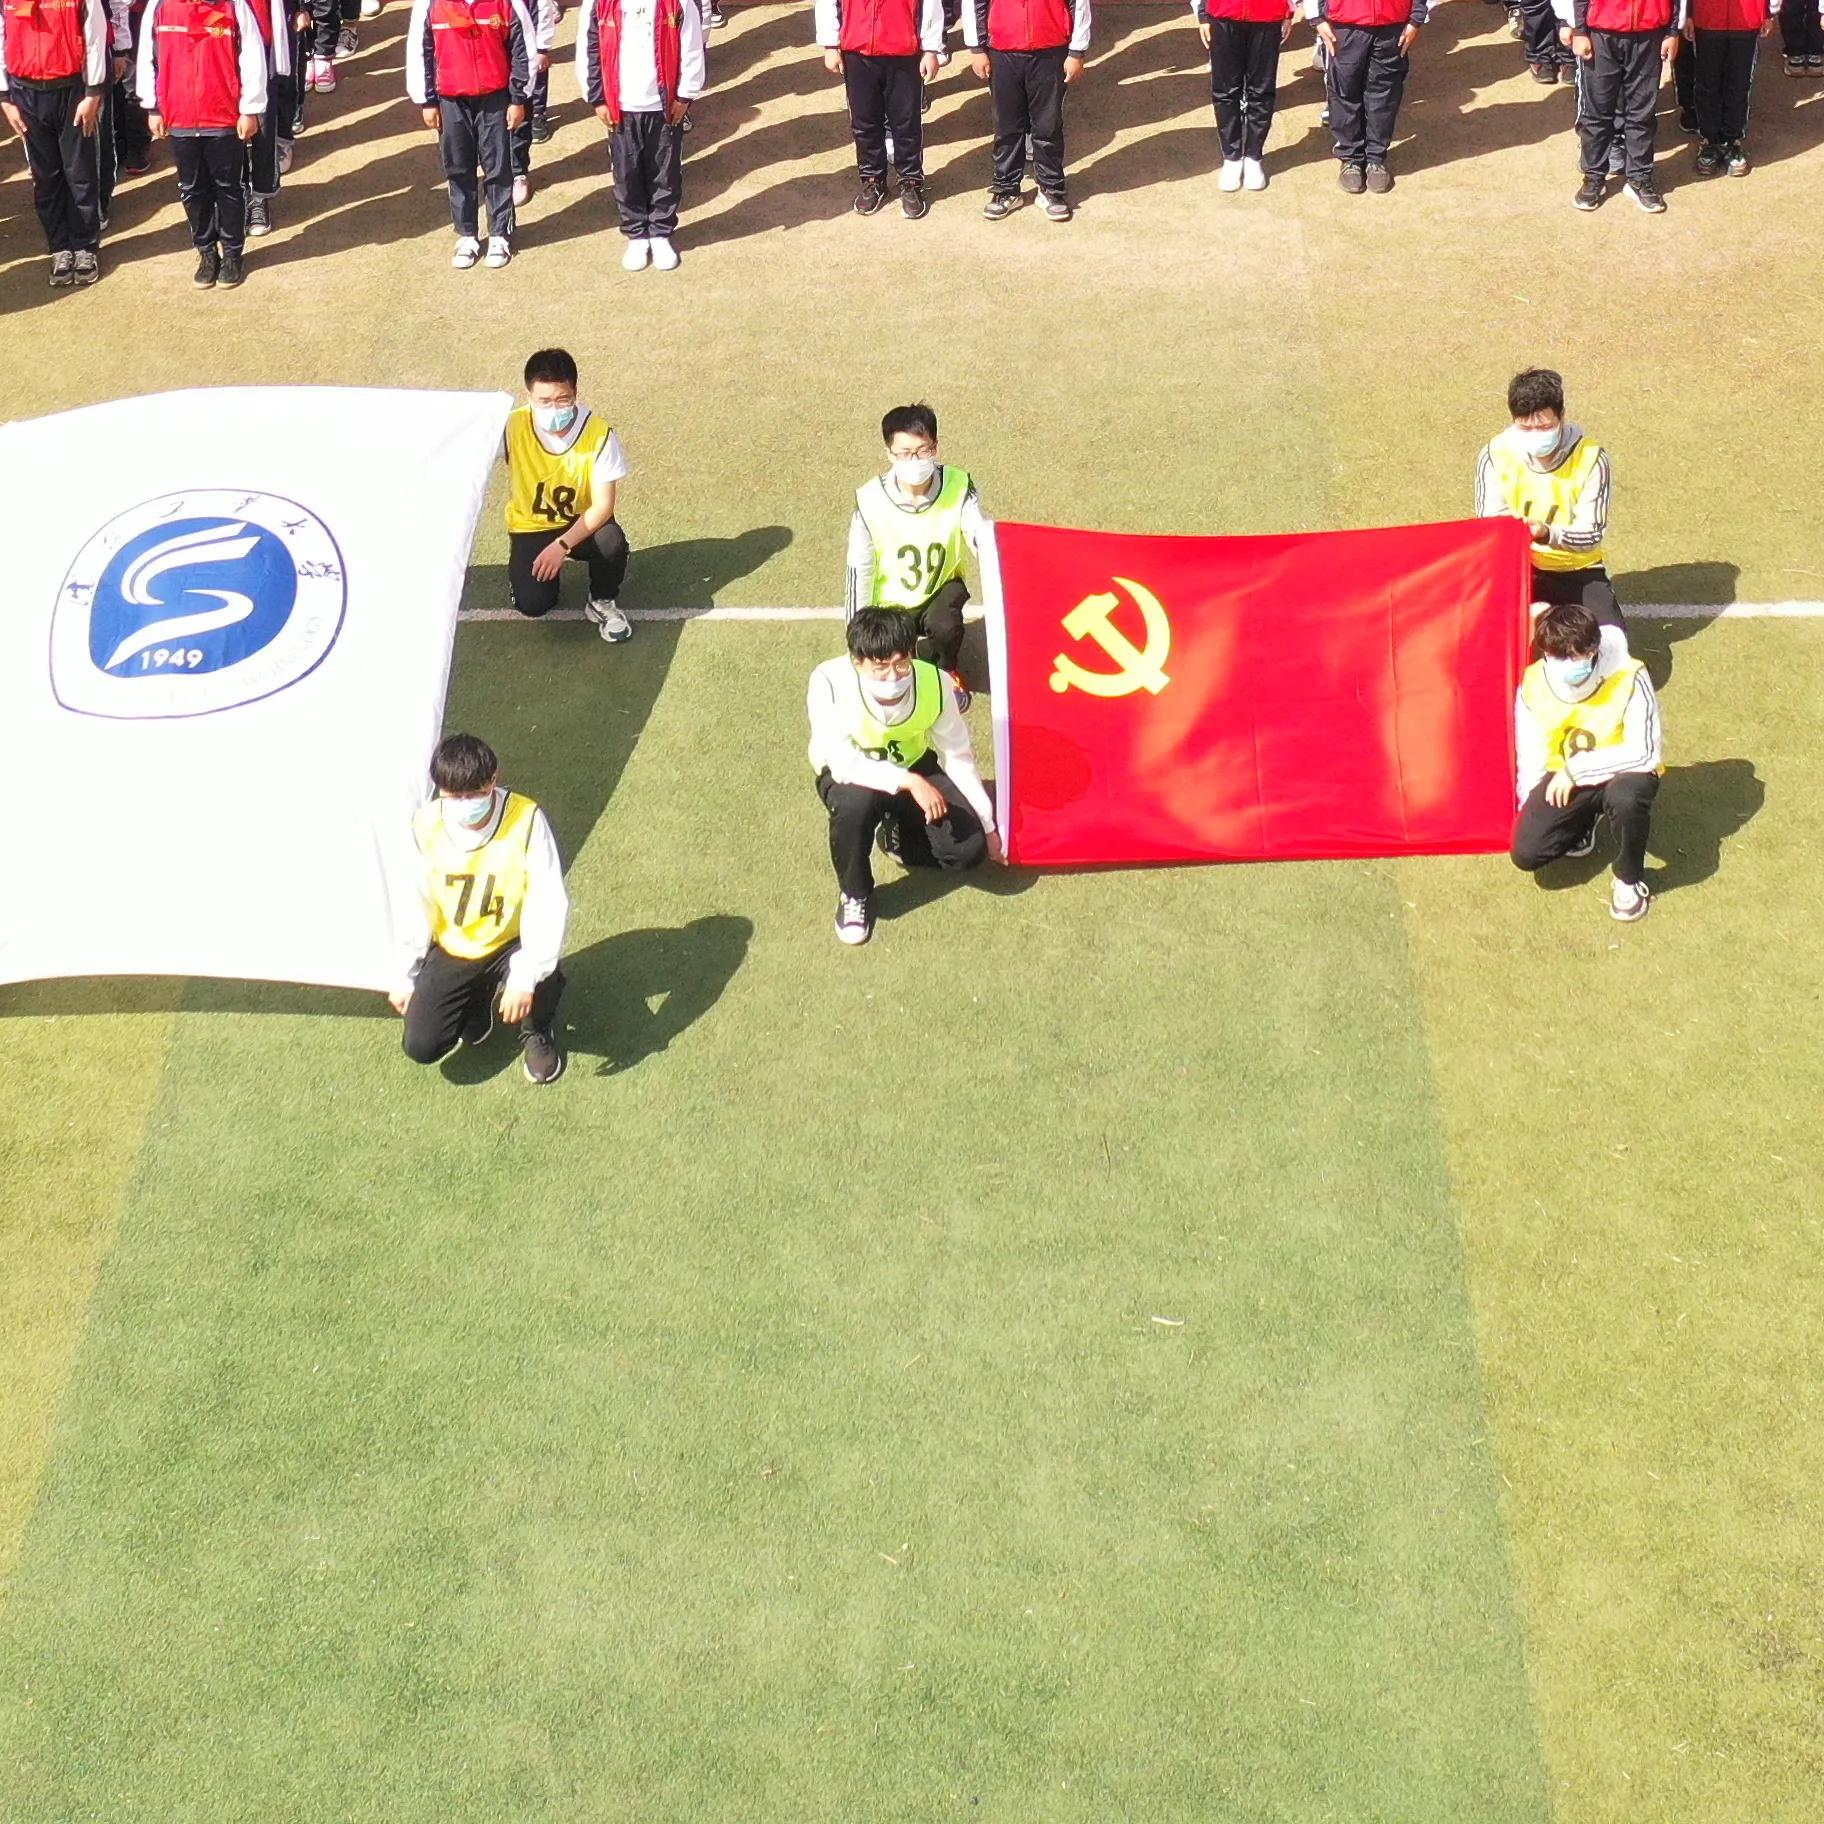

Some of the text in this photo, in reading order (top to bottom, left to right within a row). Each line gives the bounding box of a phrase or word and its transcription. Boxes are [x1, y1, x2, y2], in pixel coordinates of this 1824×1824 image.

[532, 481, 580, 523] 48
[897, 542, 946, 592] 39
[140, 648, 203, 671] 1949
[445, 873, 504, 927] 74
